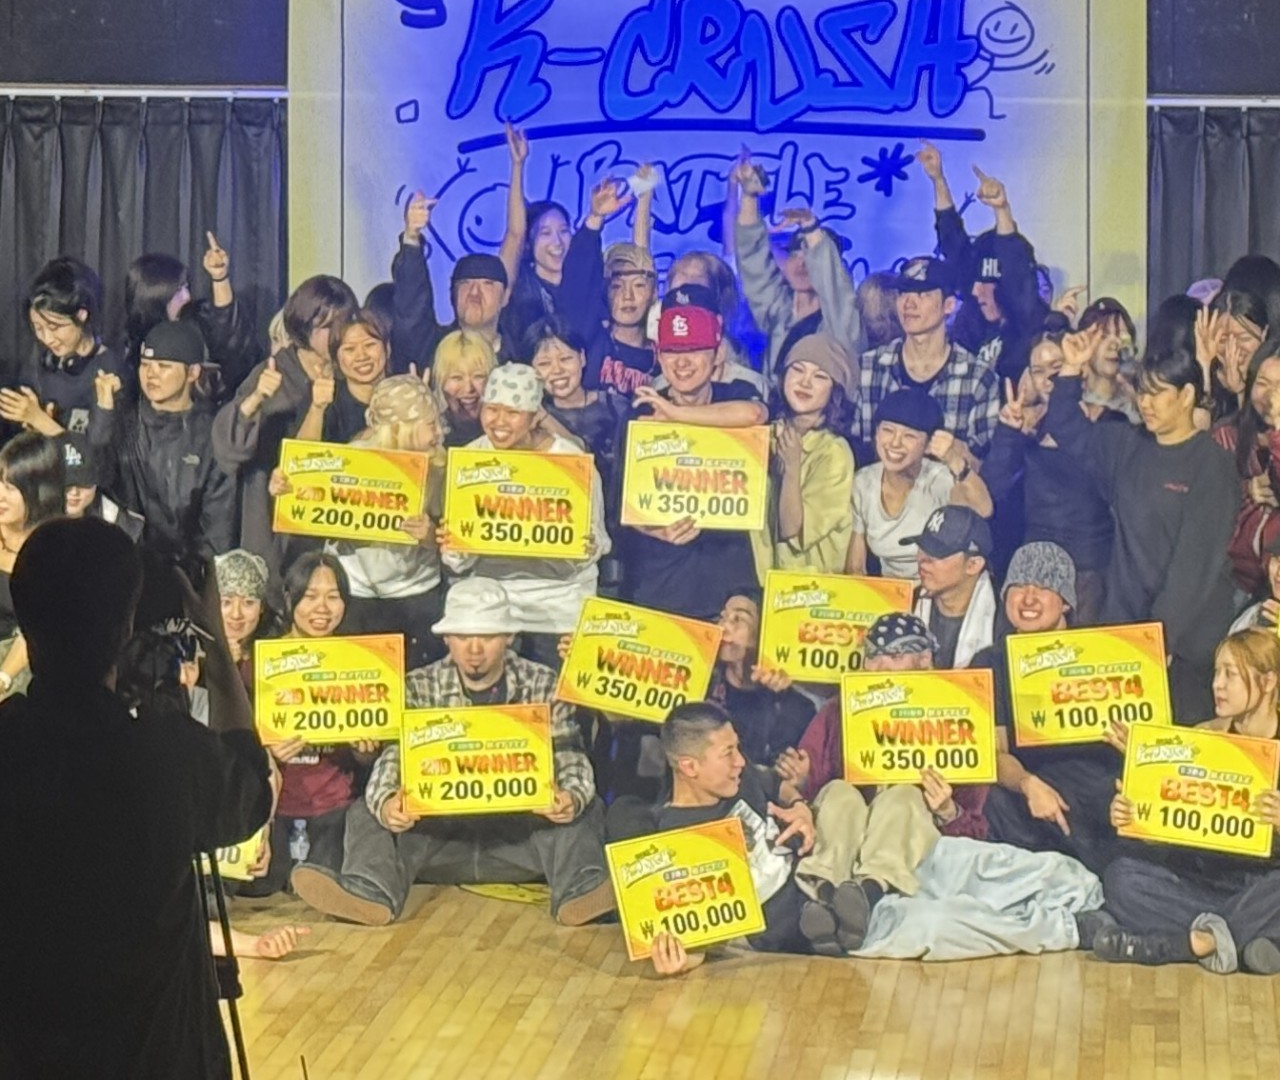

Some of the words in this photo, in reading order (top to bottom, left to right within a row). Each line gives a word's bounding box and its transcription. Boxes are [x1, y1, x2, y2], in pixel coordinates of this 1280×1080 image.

[652, 467, 749, 495] WINNER
[330, 486, 409, 512] WINNER
[474, 494, 574, 523] WINNER
[657, 494, 749, 518] 350,000
[311, 507, 405, 531] 200,000
[480, 522, 574, 546] 350,000
[798, 622, 868, 647] BEST
[597, 646, 691, 692] WINNER
[798, 647, 866, 672] 100,0
[309, 683, 390, 705] WINNER
[595, 676, 687, 710] 350,000
[1051, 674, 1144, 705] BEST4
[293, 708, 389, 733] 200,000
[1054, 701, 1153, 729] 100,000
[872, 718, 977, 746] WINNER
[455, 752, 539, 774] WINNER
[440, 777, 538, 803] 200,000
[1160, 777, 1250, 812] BEST4
[1159, 806, 1254, 839] 100,000
[654, 871, 735, 912] BEST4
[661, 899, 747, 935] 100,000
